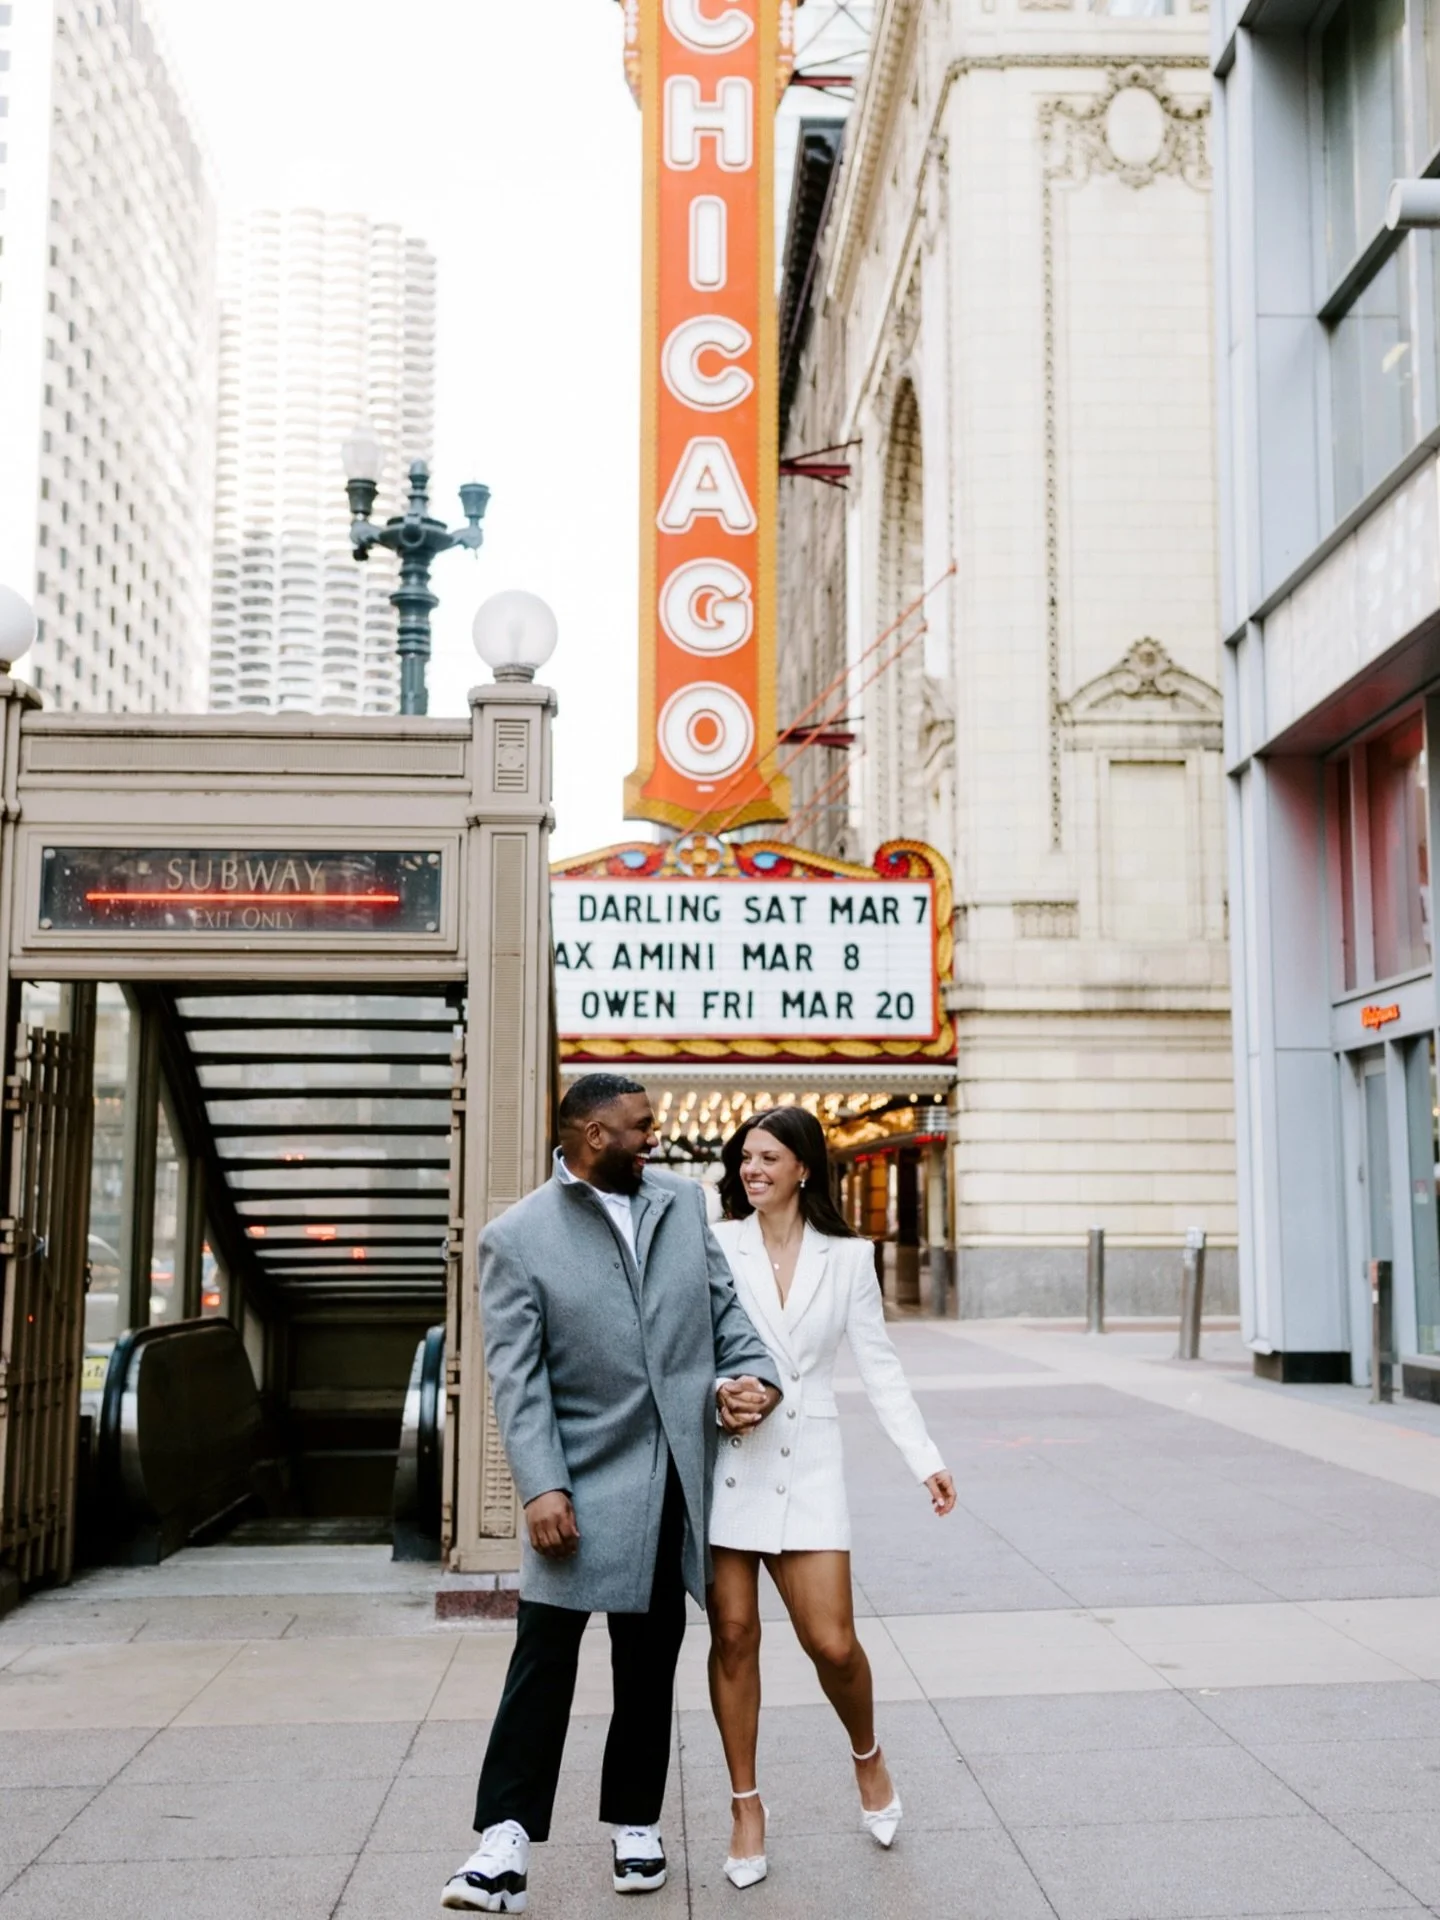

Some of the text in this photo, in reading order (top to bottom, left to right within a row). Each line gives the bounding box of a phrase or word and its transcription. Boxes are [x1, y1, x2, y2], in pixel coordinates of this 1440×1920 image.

[656, 0, 757, 782] CHICAGO
[167, 858, 323, 891] SUBWAY
[192, 907, 297, 929] EXIT ONLY
[579, 894, 928, 925] DARLING SAT MAR 7
[612, 942, 714, 971] AMINI
[742, 942, 813, 972] MAR
[843, 943, 860, 972] 8
[581, 990, 915, 1021] OWEN FRI MAR 20
